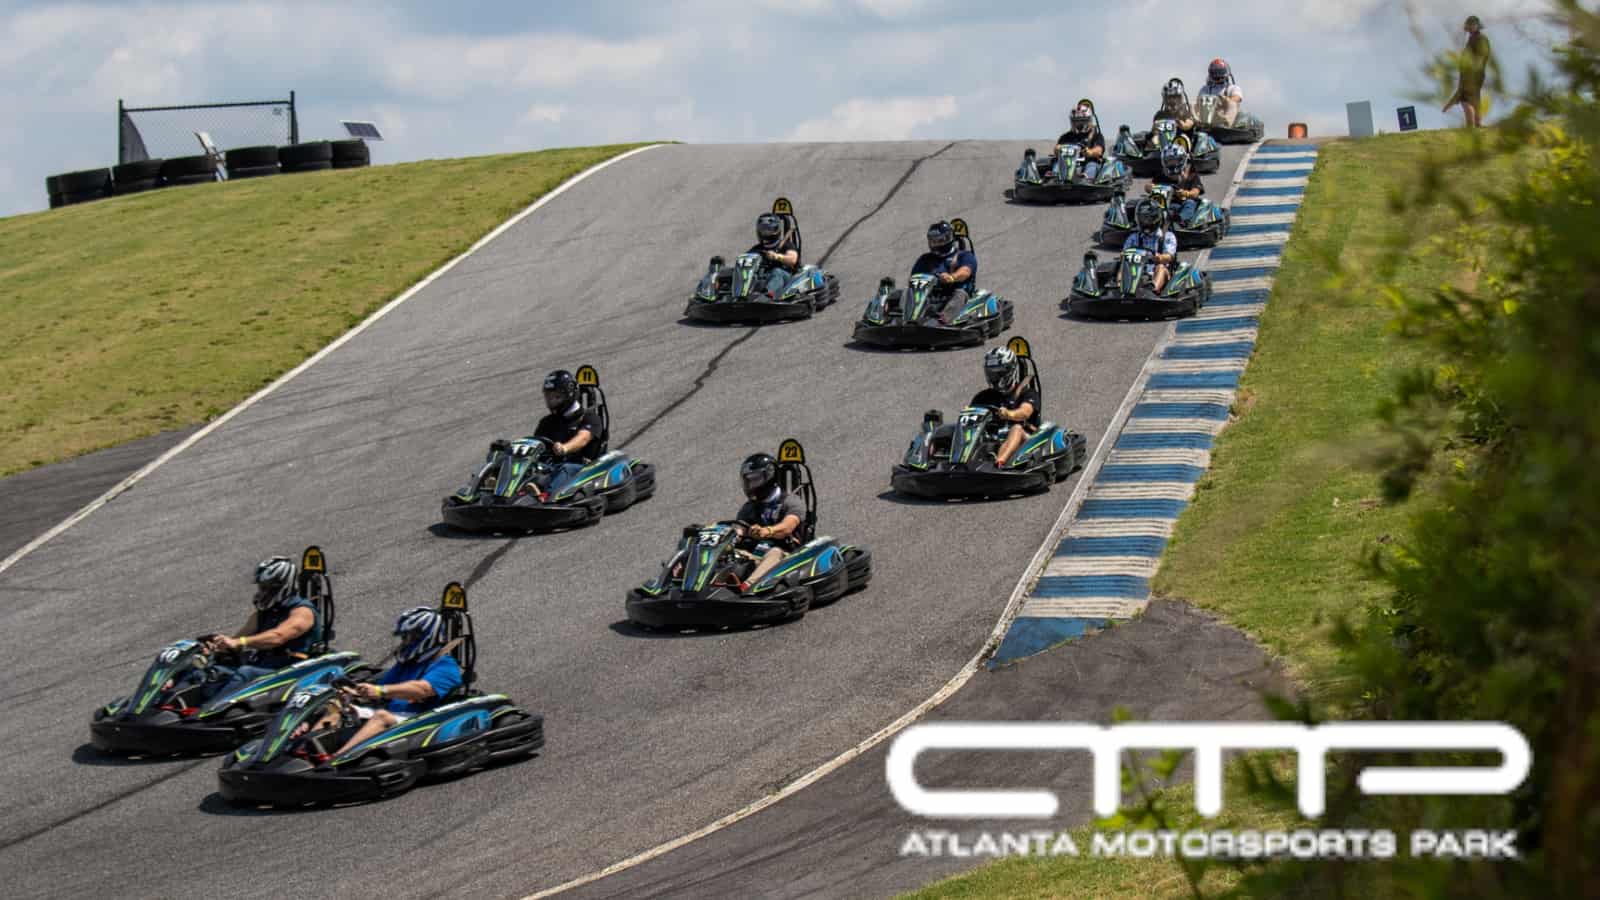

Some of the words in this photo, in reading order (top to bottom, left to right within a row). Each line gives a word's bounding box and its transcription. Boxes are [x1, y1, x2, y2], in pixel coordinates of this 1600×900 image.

[1403, 113, 1410, 124] 1
[583, 371, 592, 382] 11
[785, 446, 798, 457] 23
[699, 533, 721, 547] 23
